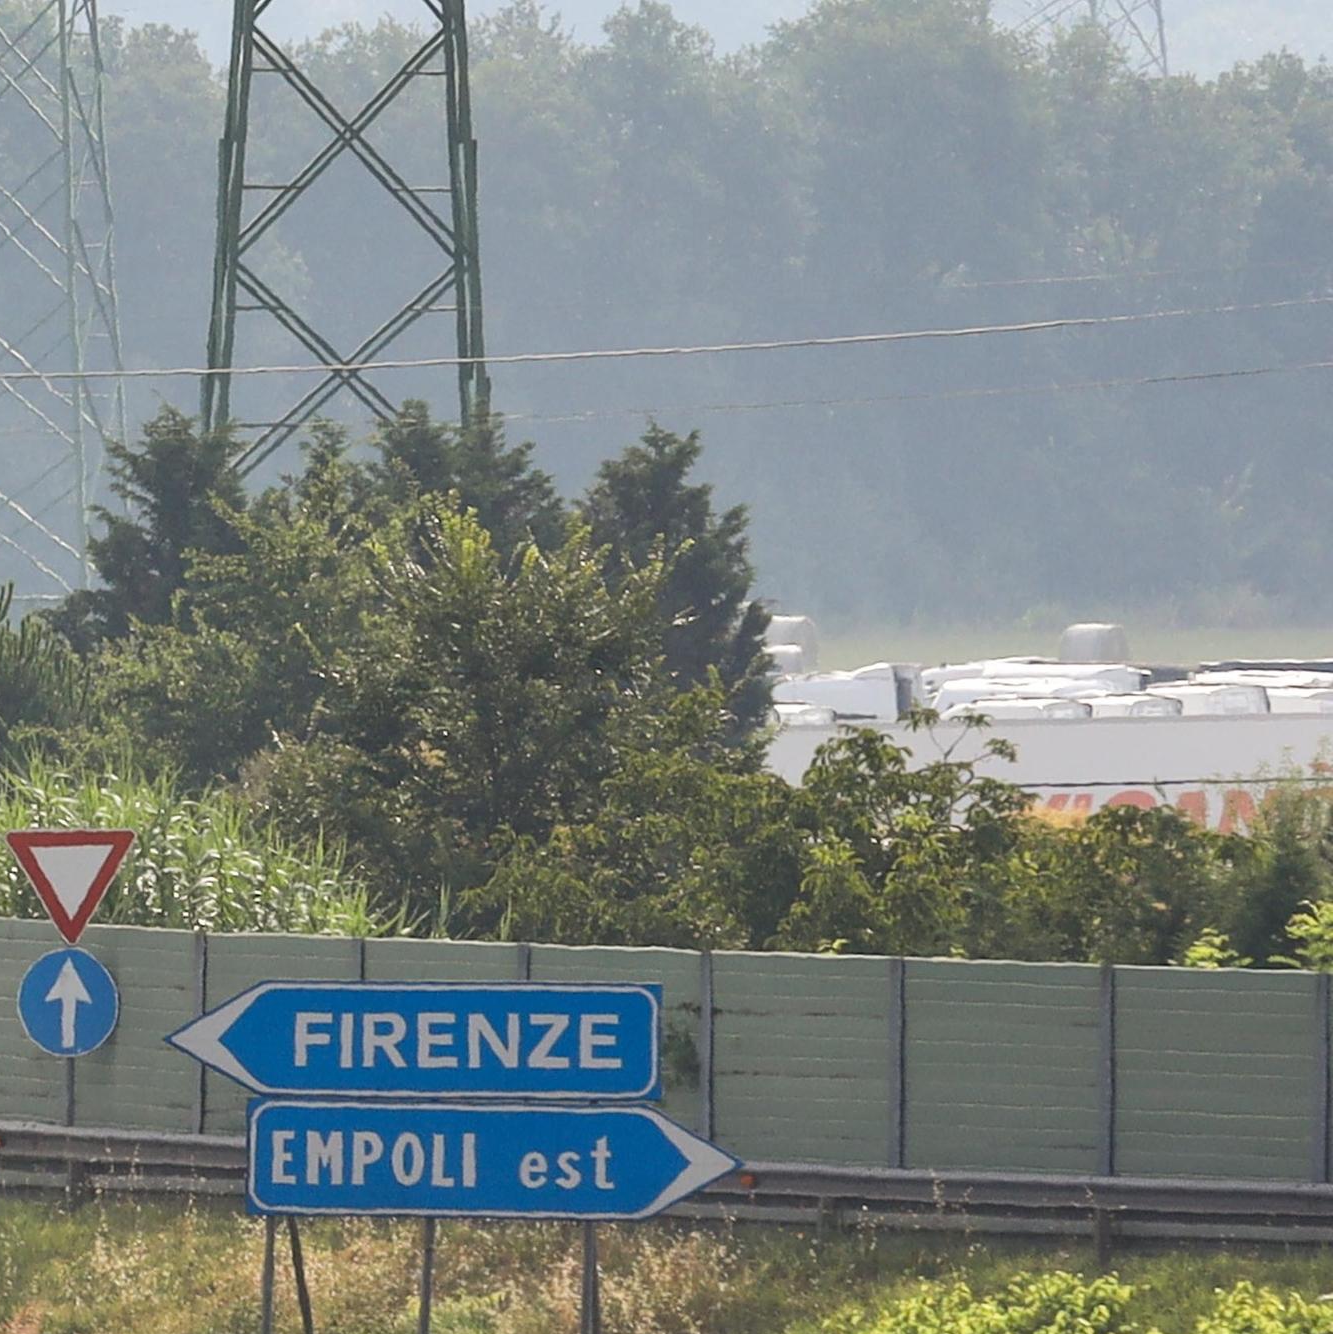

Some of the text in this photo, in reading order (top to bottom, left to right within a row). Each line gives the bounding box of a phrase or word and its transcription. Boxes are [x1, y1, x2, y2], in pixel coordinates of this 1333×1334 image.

[294, 1012, 622, 1069] FIRENZE
[271, 1130, 615, 1189] EMPOLI est
